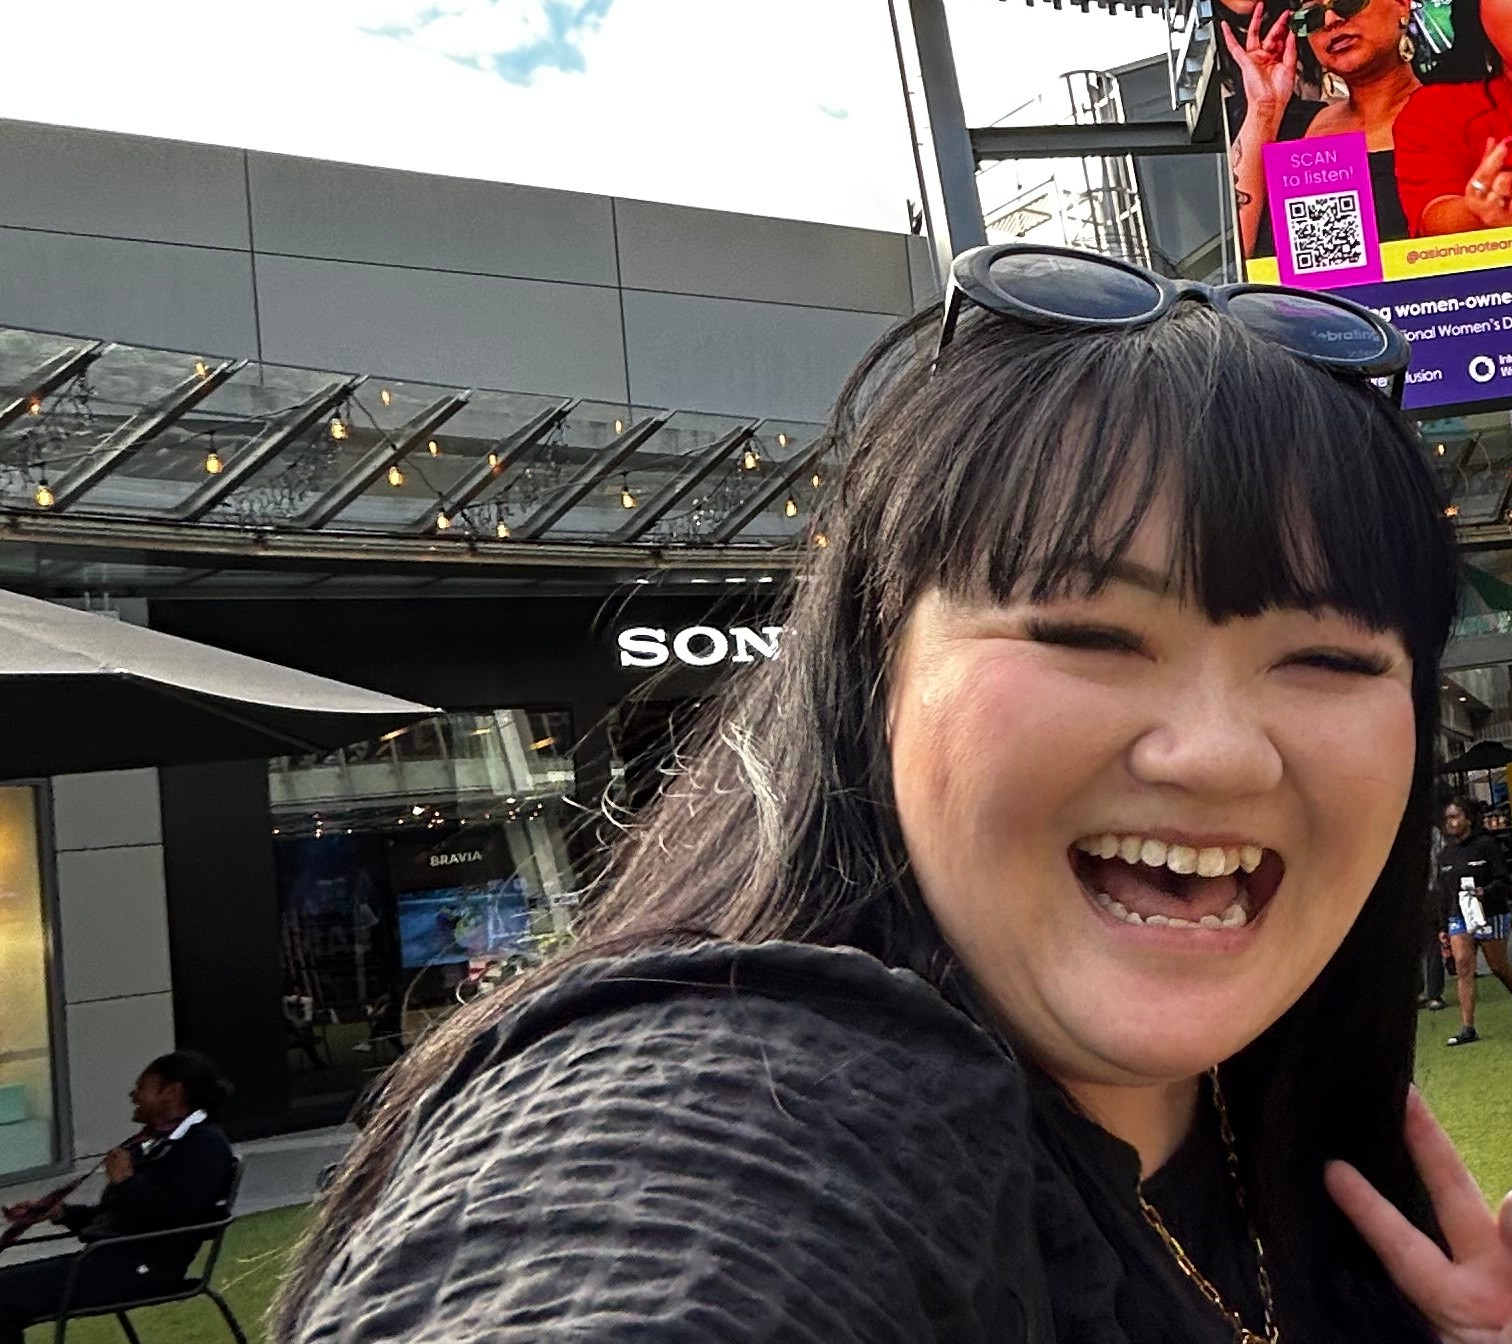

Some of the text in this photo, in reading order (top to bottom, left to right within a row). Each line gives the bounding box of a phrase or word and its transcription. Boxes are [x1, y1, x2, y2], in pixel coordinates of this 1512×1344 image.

[1290, 149, 1338, 168] SCAN
[1282, 167, 1355, 188] to listen!
[1437, 317, 1501, 337] Women's
[1404, 368, 1443, 385] lusion
[617, 625, 787, 668] SON
[429, 849, 483, 868] BRAVIA
